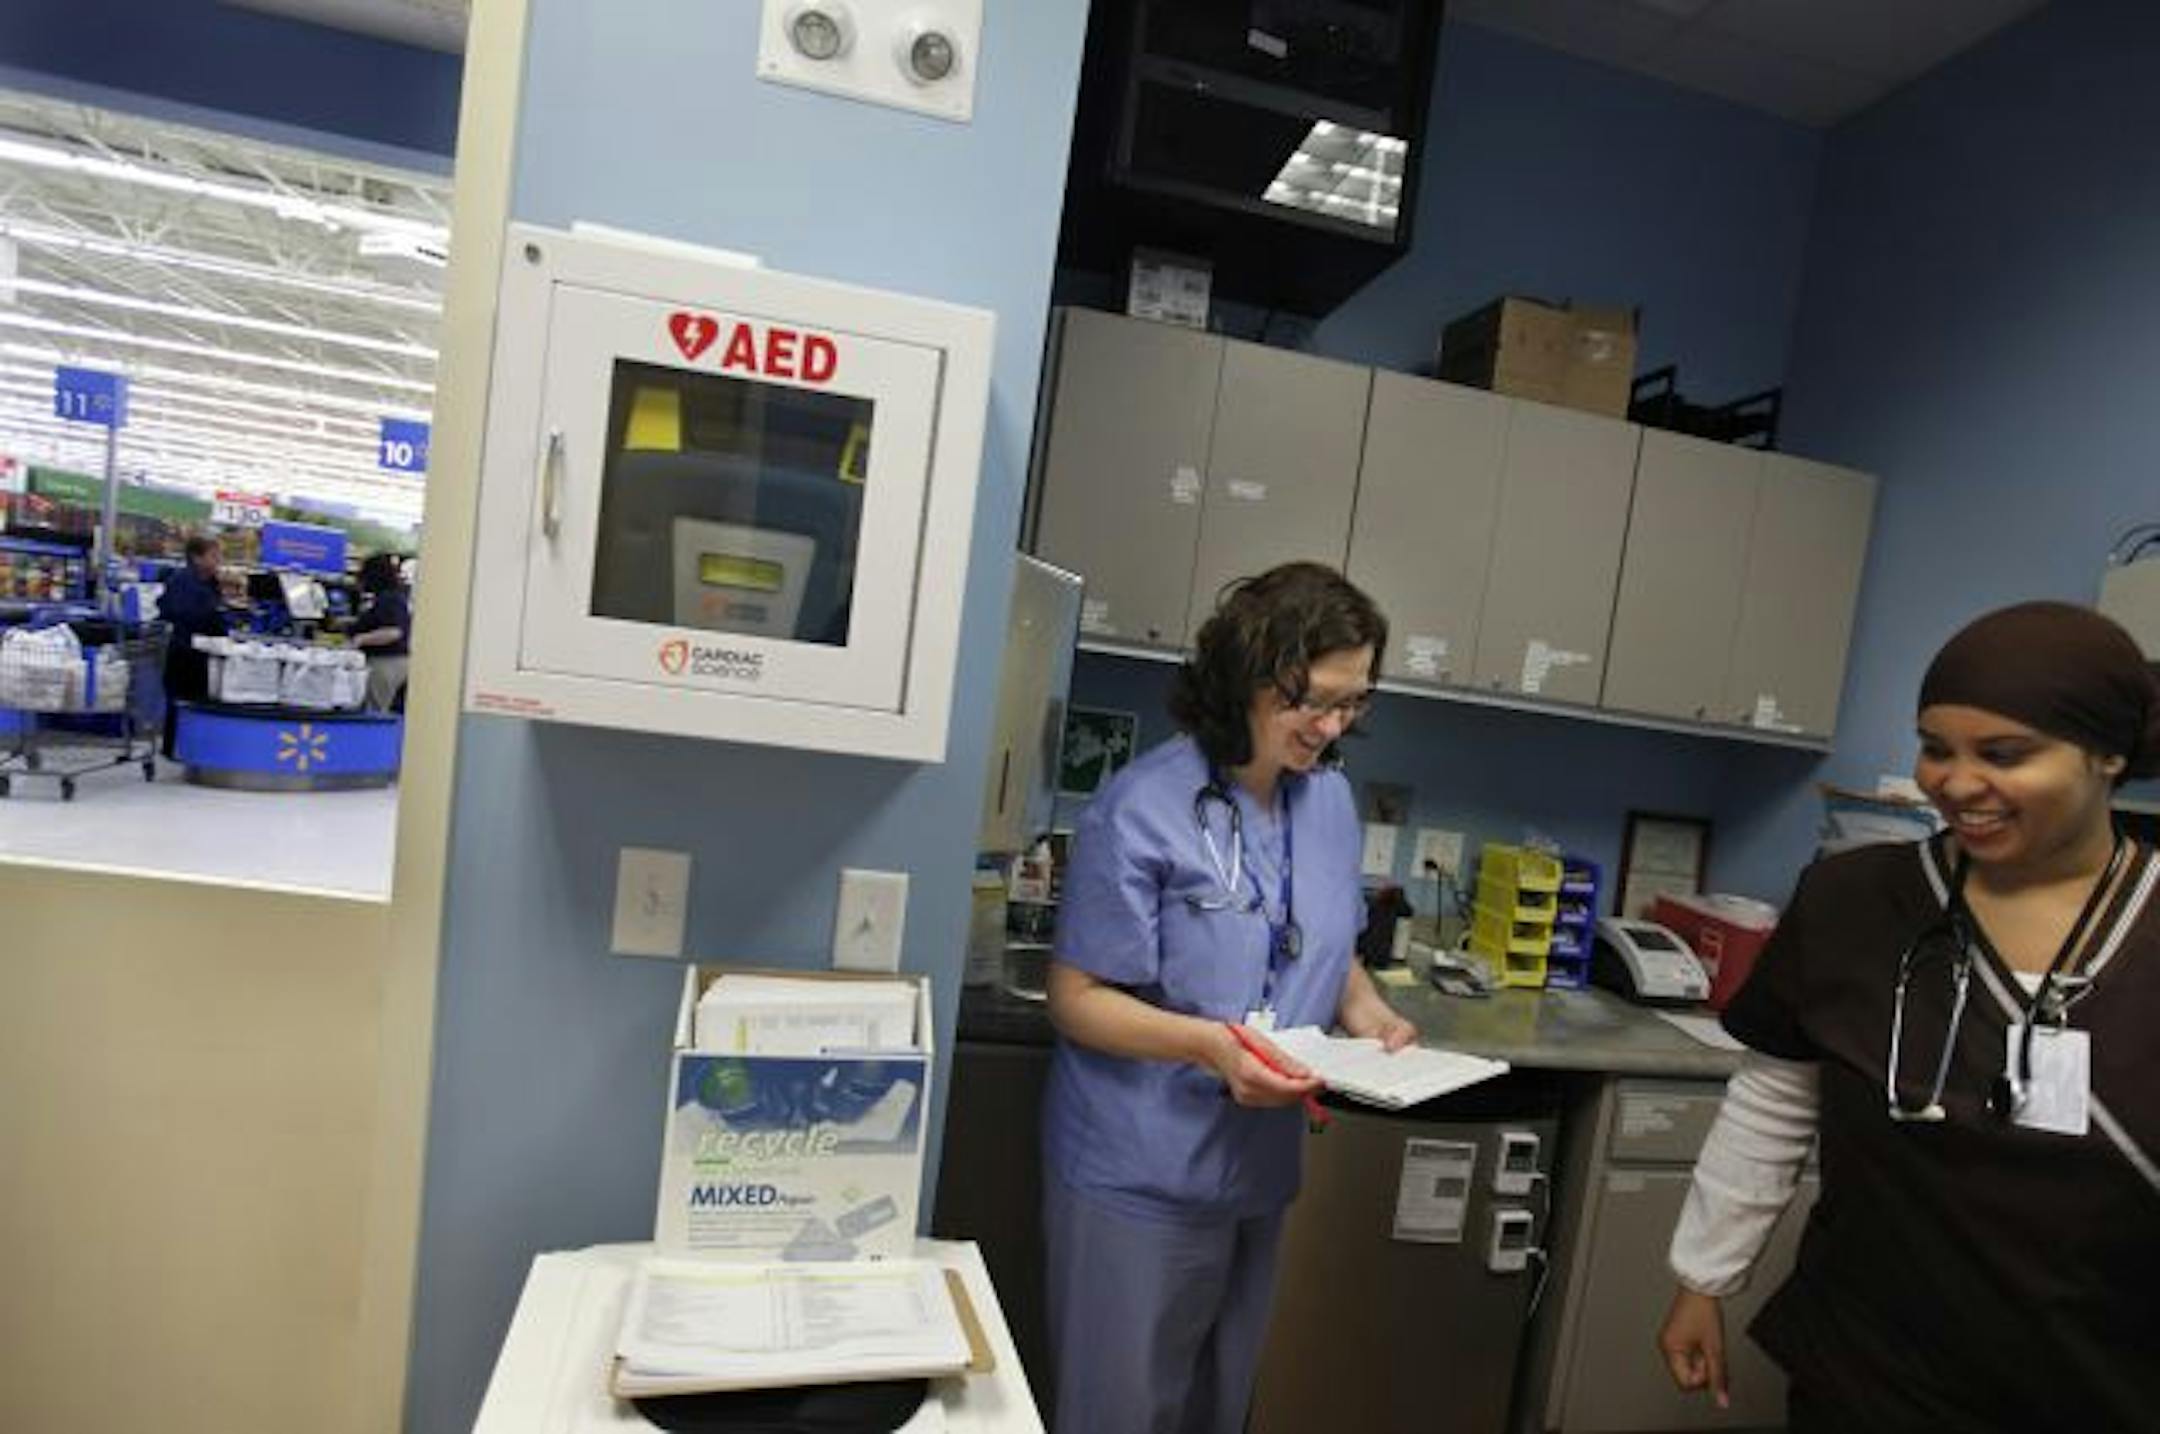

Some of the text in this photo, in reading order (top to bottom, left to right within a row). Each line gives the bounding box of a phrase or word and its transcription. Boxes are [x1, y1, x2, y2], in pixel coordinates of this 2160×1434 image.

[721, 322, 838, 385] AED
[62, 390, 87, 418] 11
[383, 440, 414, 467] 10
[692, 647, 763, 666] CARDIAC
[699, 1123, 838, 1162] recycle
[690, 1183, 777, 1207] MIXED
